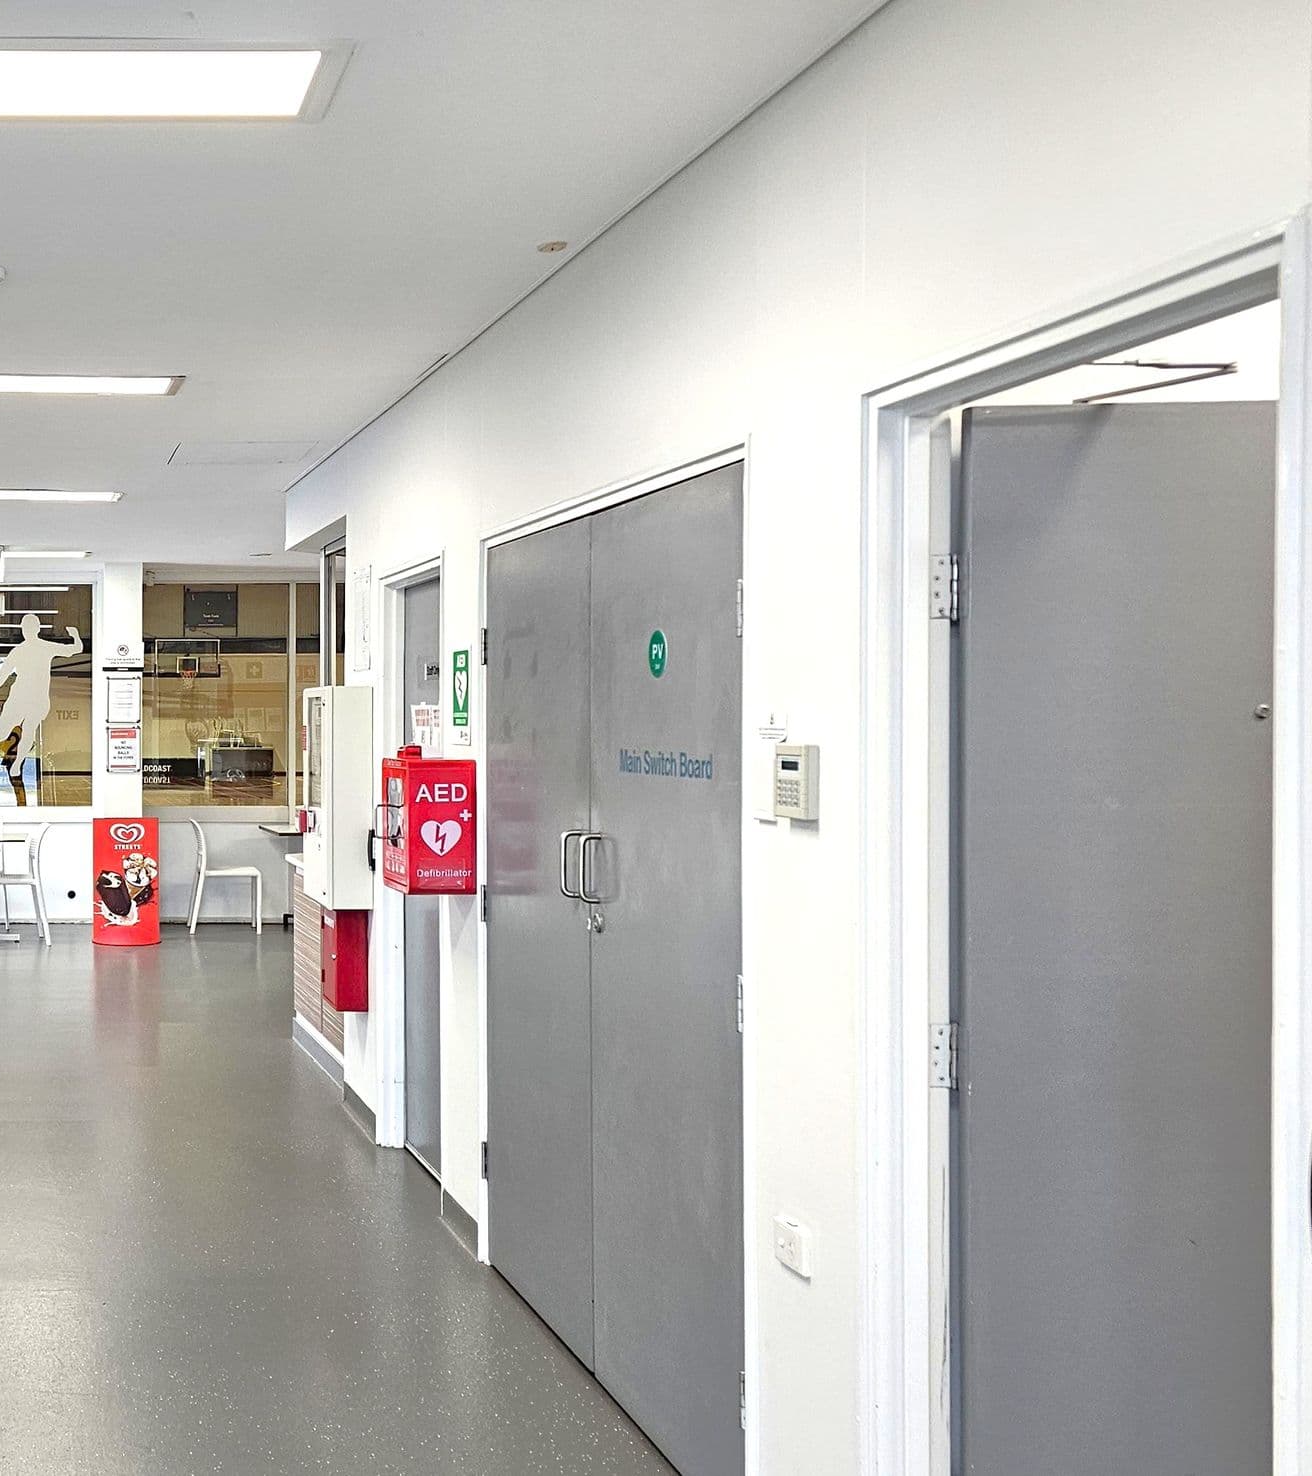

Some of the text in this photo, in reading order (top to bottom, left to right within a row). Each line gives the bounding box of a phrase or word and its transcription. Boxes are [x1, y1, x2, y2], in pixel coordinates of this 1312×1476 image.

[651, 643, 664, 660] PV
[142, 764, 172, 772] DCOAST
[619, 748, 713, 780] Main Switch Board
[415, 783, 468, 803] AED
[416, 868, 473, 878] Defibrillator
